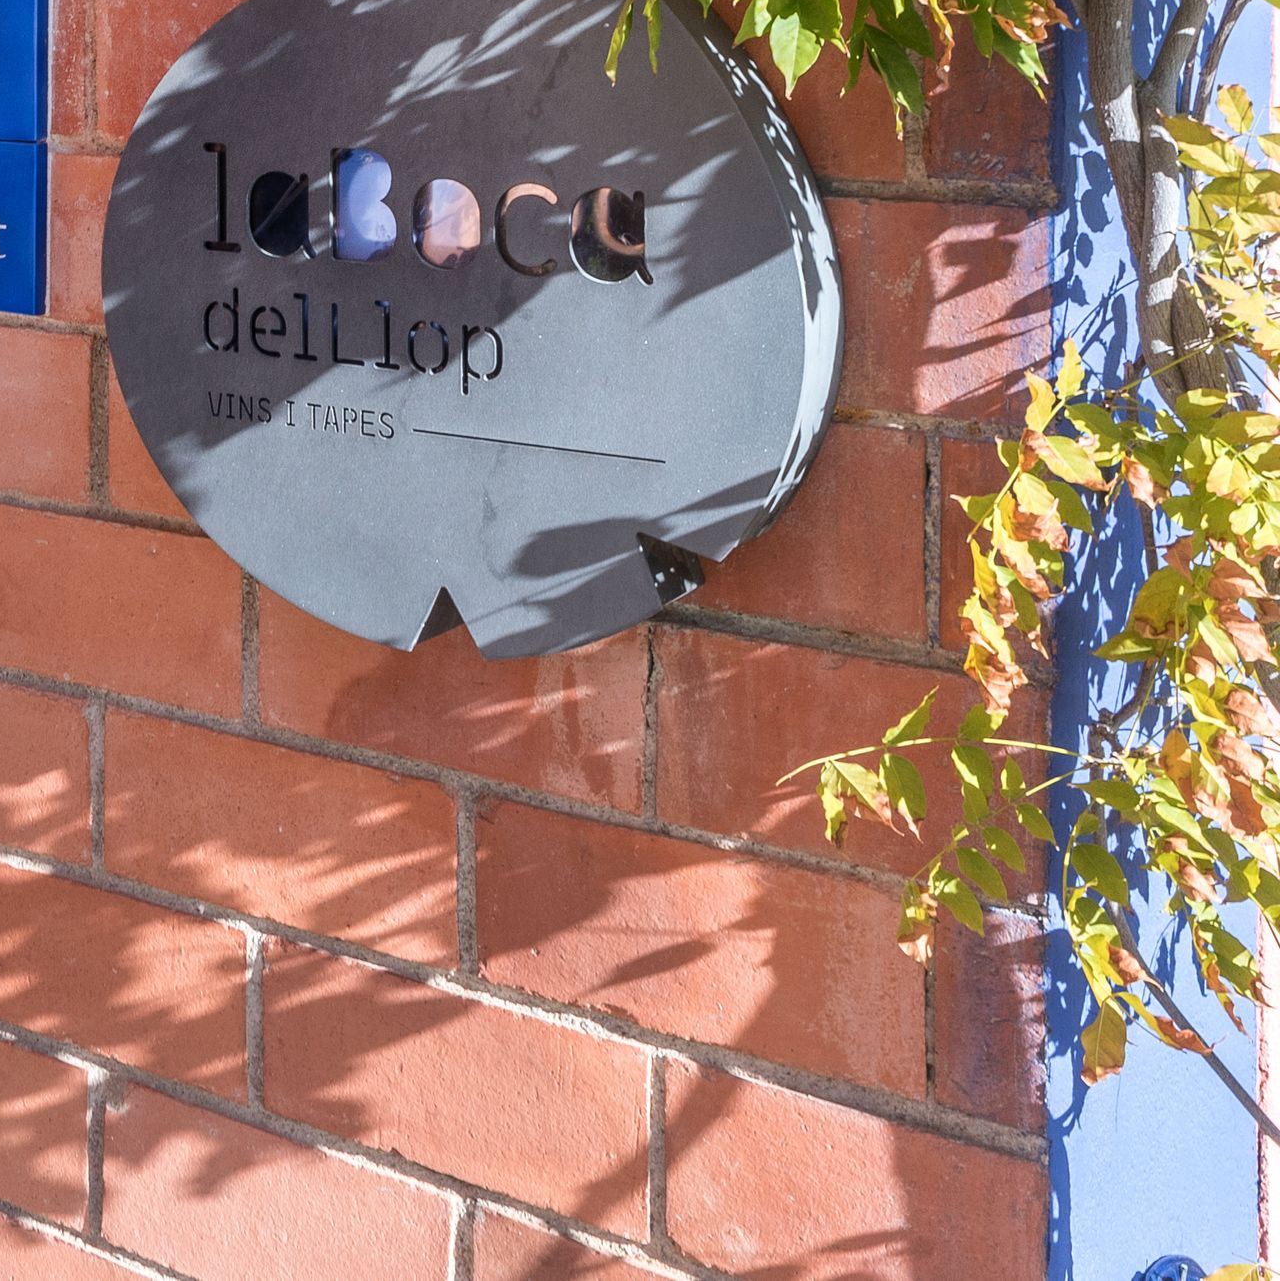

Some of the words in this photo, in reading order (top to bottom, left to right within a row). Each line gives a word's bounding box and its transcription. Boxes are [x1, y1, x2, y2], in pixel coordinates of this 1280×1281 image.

[203, 142, 654, 286] laBoca
[203, 288, 505, 396] delLlop
[208, 390, 272, 424] VINS
[284, 400, 297, 428] I
[306, 402, 395, 440] TAPES
